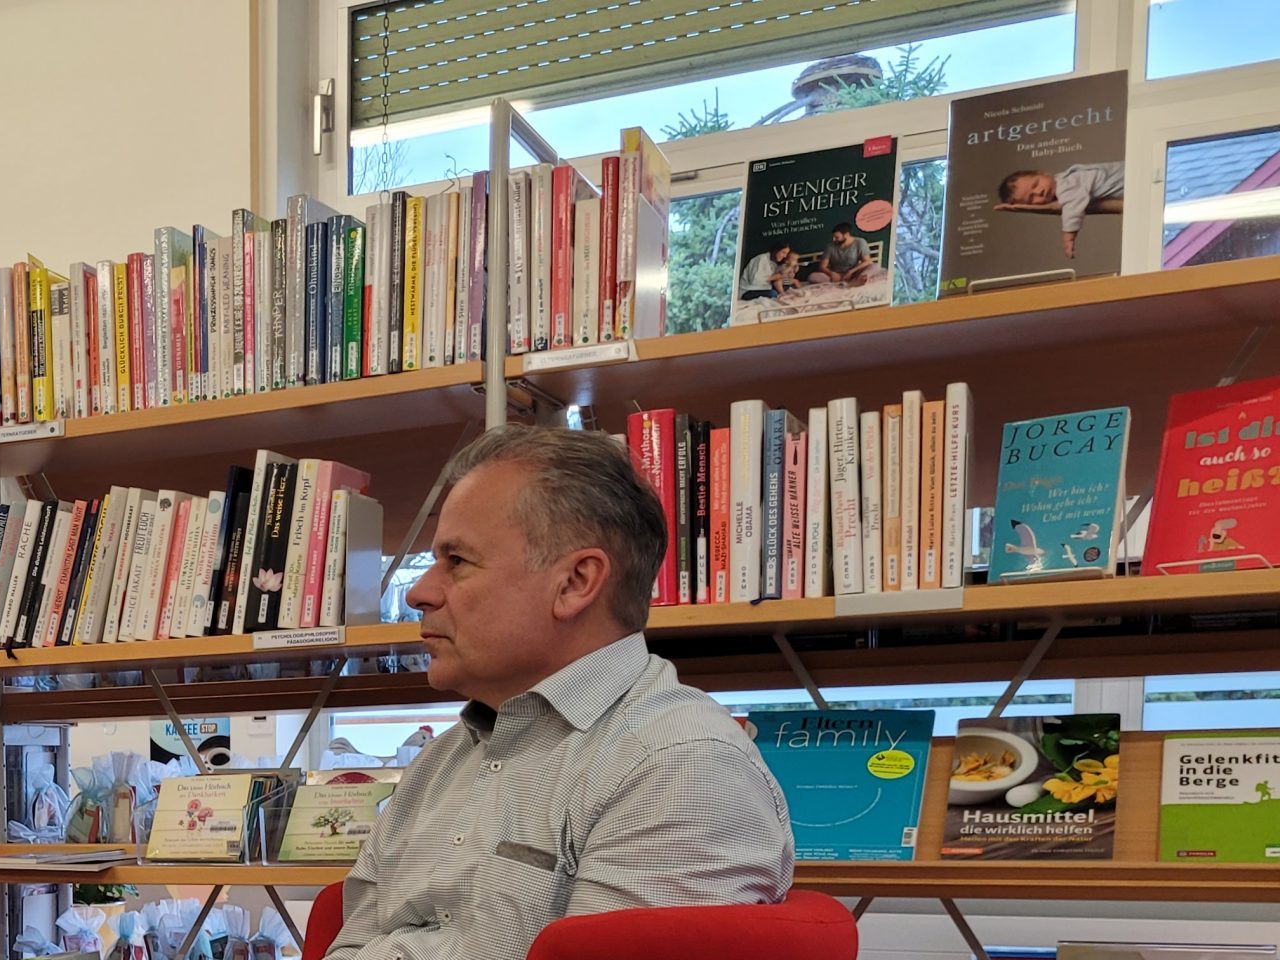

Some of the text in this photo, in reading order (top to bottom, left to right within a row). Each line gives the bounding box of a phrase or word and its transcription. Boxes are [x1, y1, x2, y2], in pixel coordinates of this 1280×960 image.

[967, 105, 1113, 145] artgerecht
[984, 108, 1010, 119] Nicola
[1016, 136, 1070, 152] Das andere
[1031, 143, 1083, 159] Baby-Buch
[773, 171, 867, 200] WENIGER
[763, 189, 859, 218] IST MEHR
[118, 331, 126, 374] GLÜCKLICH
[847, 424, 856, 465] Kritiker
[1004, 411, 1123, 449] JORGE
[1184, 427, 1229, 449] Ist
[833, 416, 847, 483] Jäger, Hirten,
[950, 403, 960, 498] LETZTE-HILFE-KURS
[1005, 433, 1123, 465] BUCAY
[1200, 446, 1271, 466] auch so
[697, 443, 707, 517] Bestie Mensch
[1048, 483, 1110, 499] Wer bin ich?
[272, 476, 288, 538] Das weise Herz
[292, 477, 312, 546] Frisch im Kopf
[768, 472, 778, 556] GLÜCK DES GEHENS
[789, 470, 801, 550] ALTE WEISSE MÄNNER
[845, 498, 857, 539] Precht
[871, 503, 879, 531] Precht
[1021, 502, 1049, 513] Wohin
[1076, 495, 1099, 506] ich?
[1042, 506, 1112, 523] Und mit wem?
[35, 545, 44, 567] dunkle
[40, 505, 53, 546] Leidenschaft
[124, 505, 134, 541] HOCHBEGABT
[134, 511, 150, 555] FREUT EUCH
[736, 500, 744, 544] MICHELLE
[745, 506, 753, 538] OBAMA
[836, 513, 844, 548] Richard
[11, 520, 32, 597] HALLER RACHE
[54, 588, 63, 608] HERBST
[71, 524, 79, 541] MAN
[202, 522, 219, 586] Konzentration
[165, 723, 217, 736] KAFEE STOP
[774, 720, 907, 752] family
[1179, 753, 1280, 764] Gelenkfit
[1179, 765, 1233, 775] in die
[177, 783, 191, 792] Das
[204, 781, 231, 791] Hörbuch
[314, 790, 328, 799] Das
[345, 789, 373, 798] Hörbuch
[1179, 776, 1240, 789] Berge
[960, 824, 1093, 835] die wirklich helfen
[963, 808, 1098, 824] Hausmittel,
